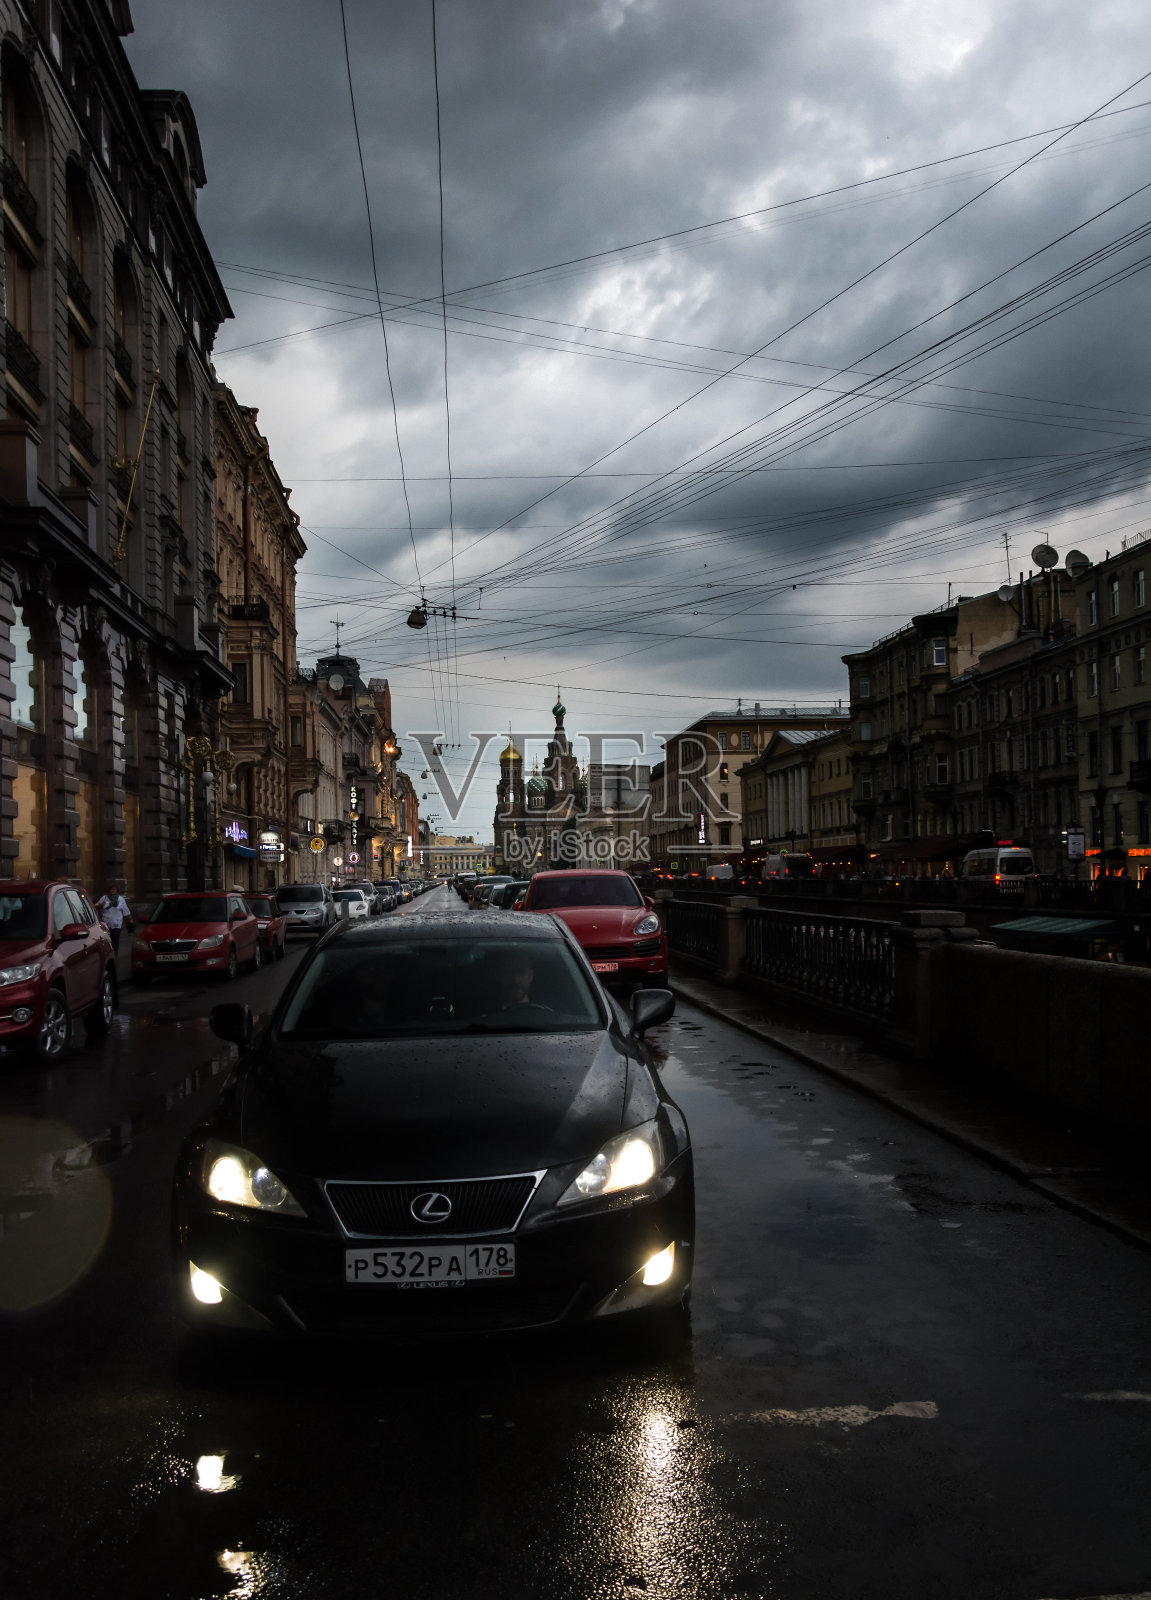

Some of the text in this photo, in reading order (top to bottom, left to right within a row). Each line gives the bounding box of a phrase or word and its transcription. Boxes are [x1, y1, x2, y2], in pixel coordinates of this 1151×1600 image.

[469, 1247, 509, 1268] 178
[477, 1267, 498, 1276] RUS
[413, 1281, 448, 1289] LEXUS
